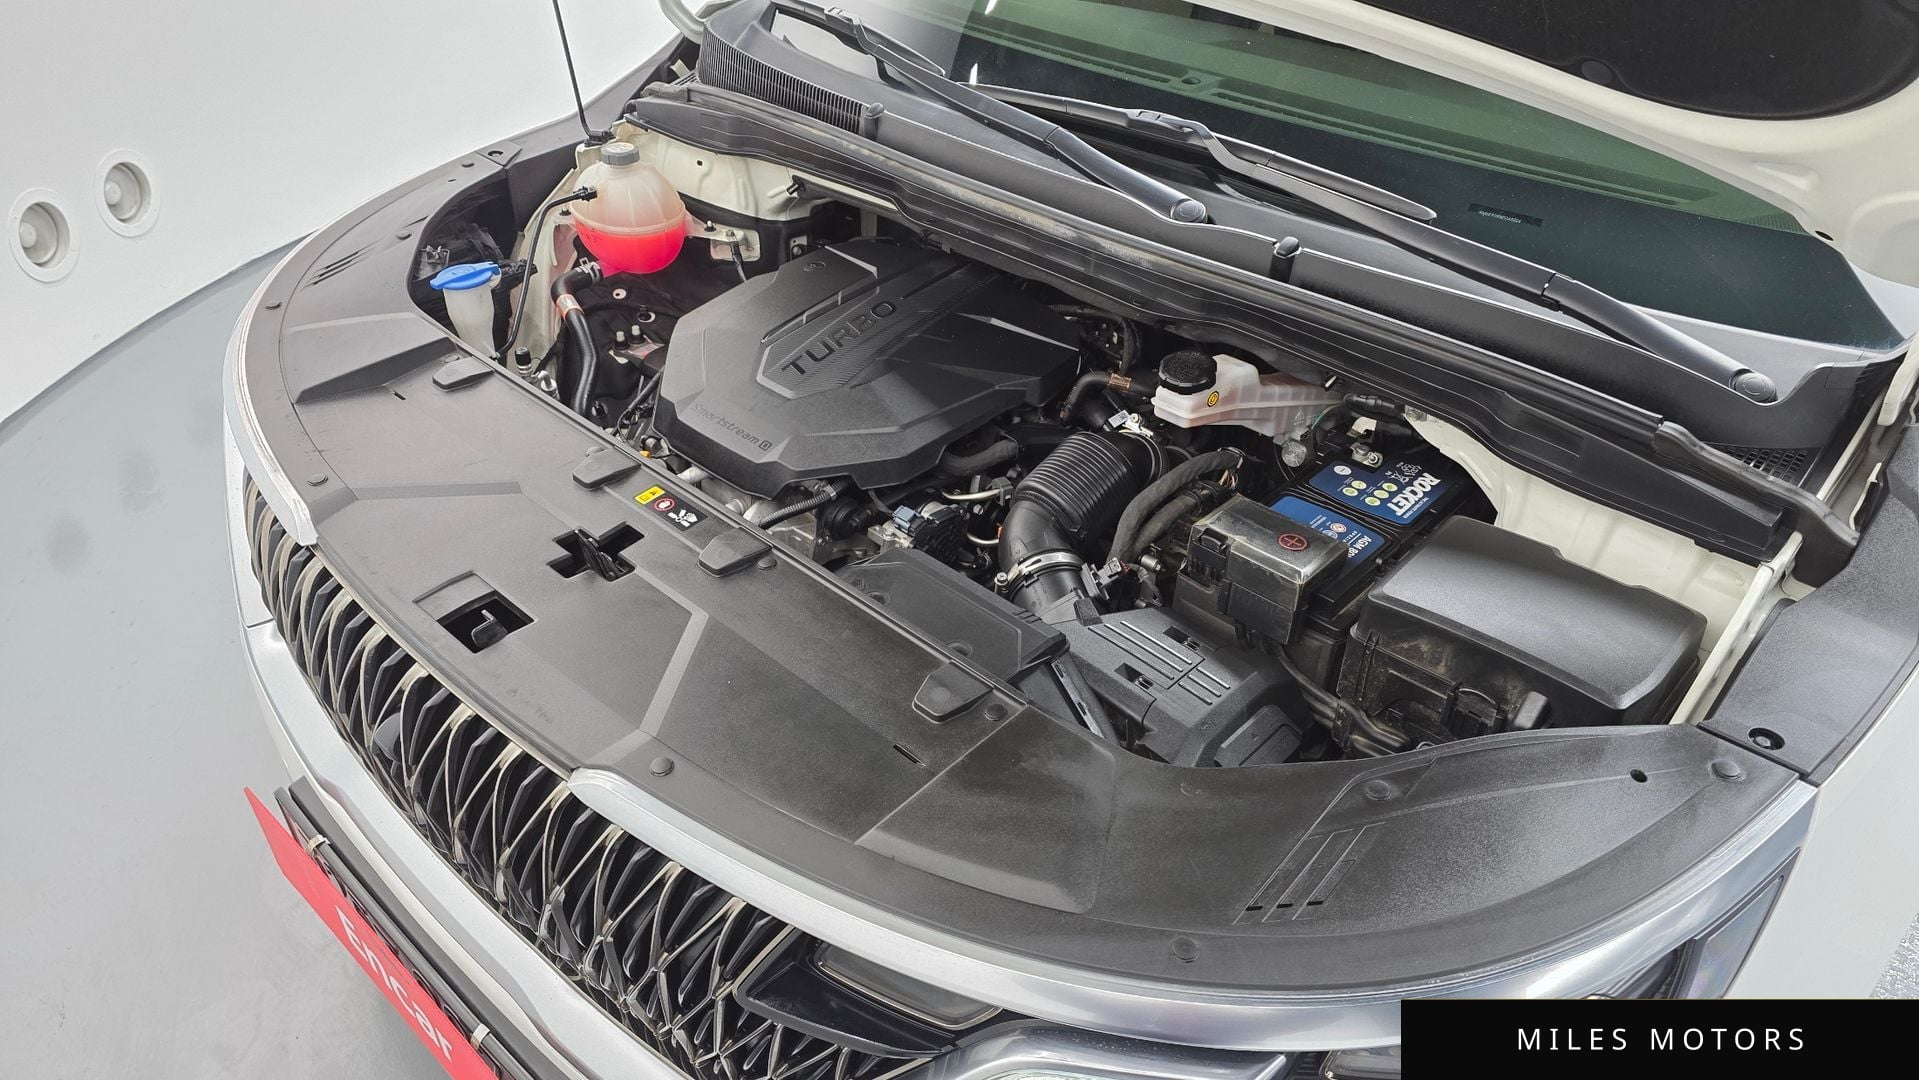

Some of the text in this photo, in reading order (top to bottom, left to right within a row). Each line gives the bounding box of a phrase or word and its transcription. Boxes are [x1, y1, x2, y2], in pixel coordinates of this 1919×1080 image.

[781, 301, 897, 375] TURBO
[1386, 472, 1441, 516] ROCKET
[1353, 535, 1372, 550] AGM
[335, 904, 453, 1062] Encar
